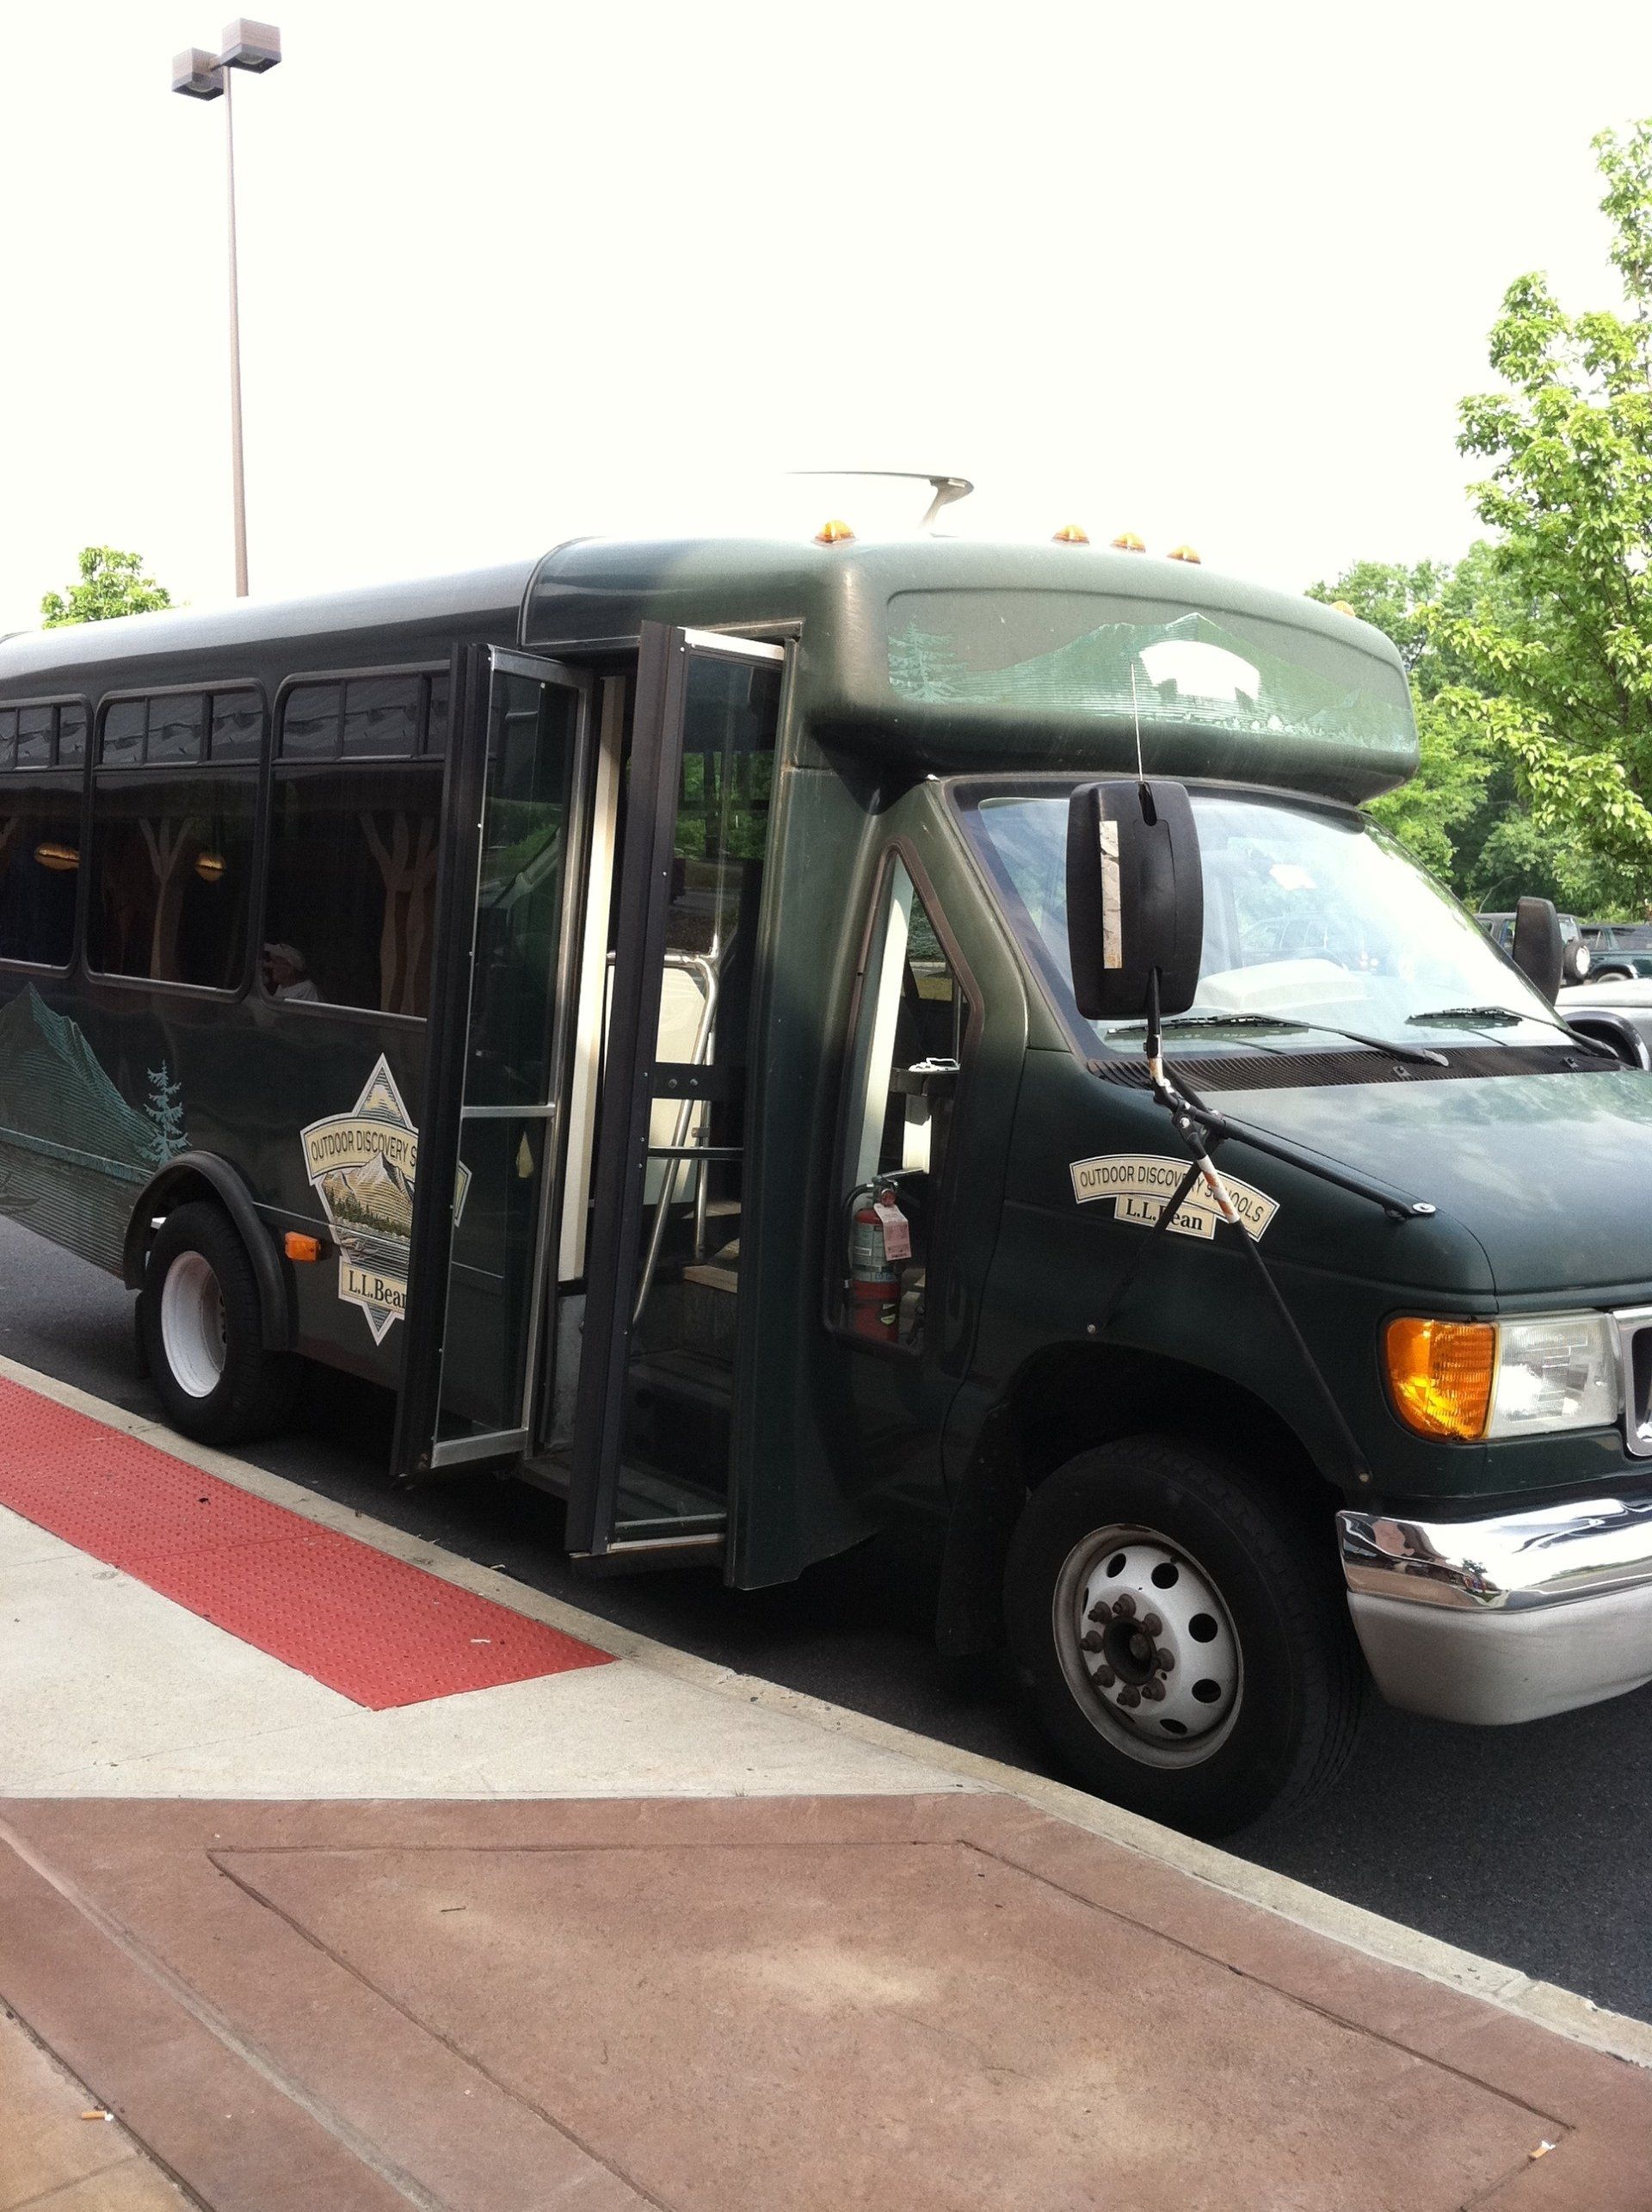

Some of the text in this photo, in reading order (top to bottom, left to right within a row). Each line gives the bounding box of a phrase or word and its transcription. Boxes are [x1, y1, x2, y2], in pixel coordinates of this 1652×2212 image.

[311, 1129, 354, 1162] OUTDOOR
[356, 1130, 410, 1161] DISCOVERY
[1080, 1166, 1264, 1223] OUTDOOR DISCOVY SOOLS
